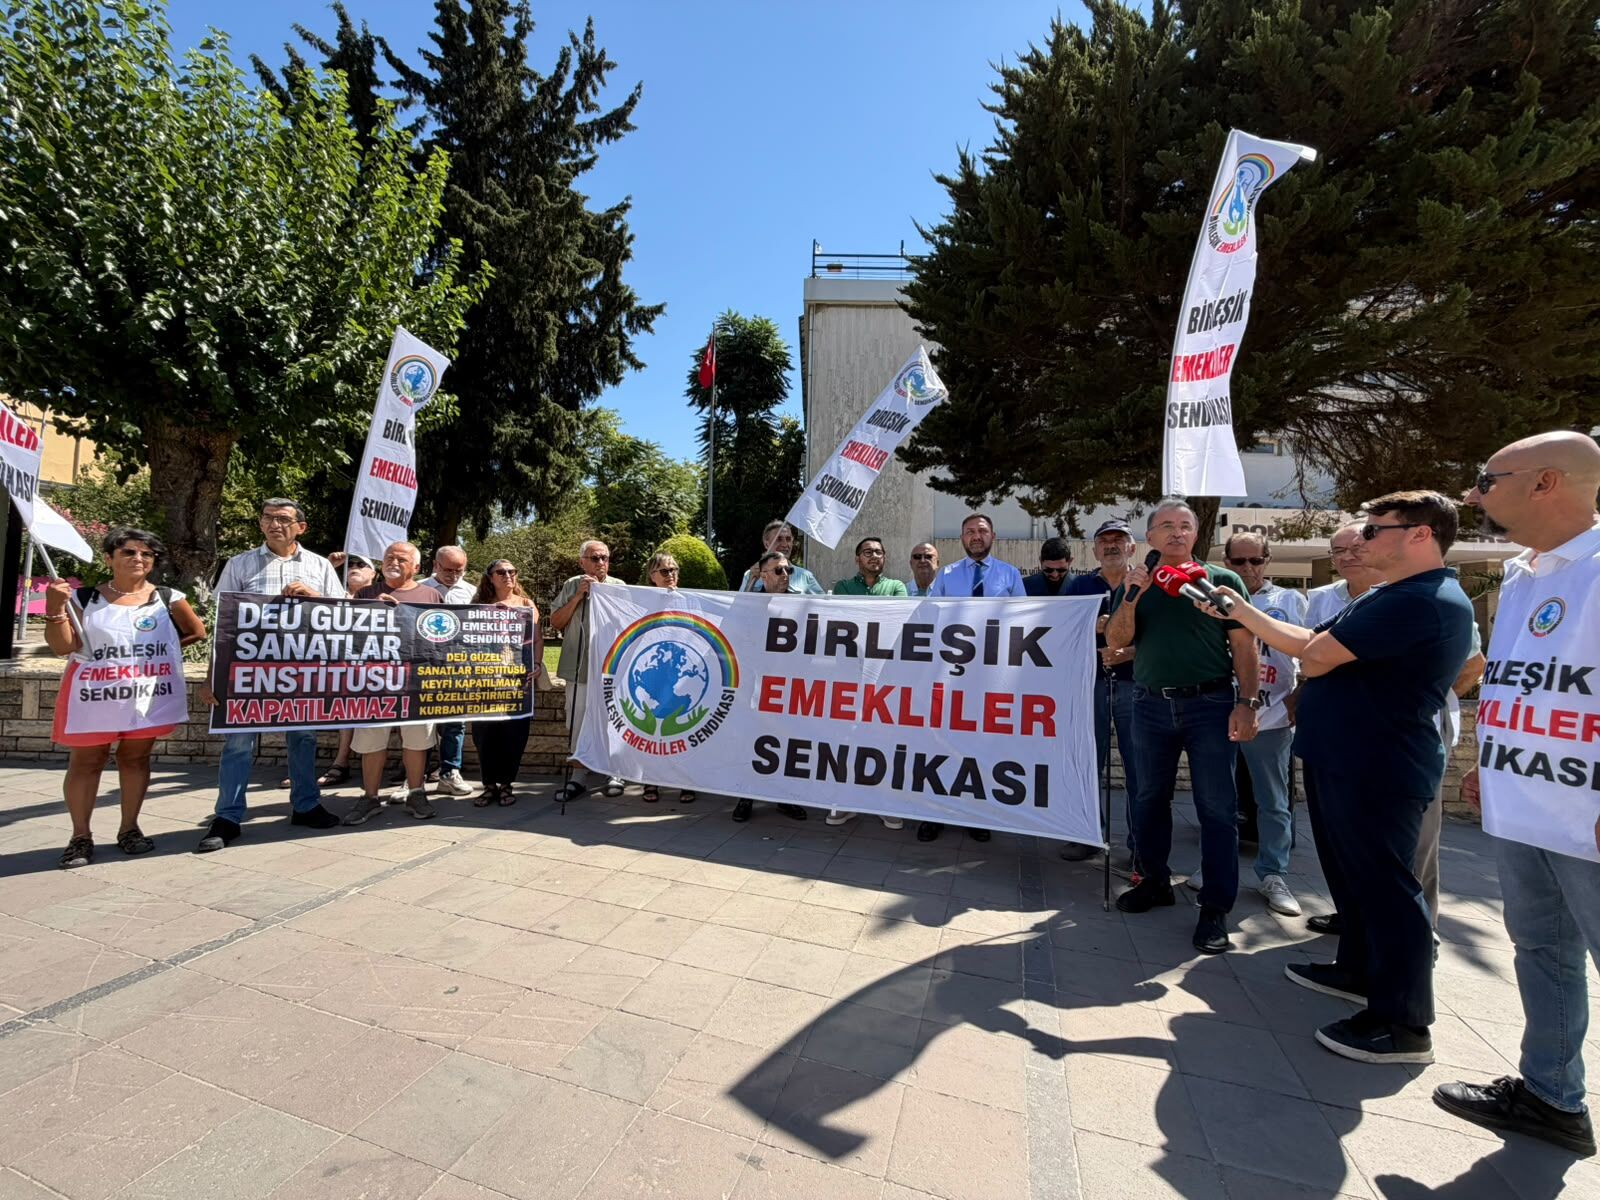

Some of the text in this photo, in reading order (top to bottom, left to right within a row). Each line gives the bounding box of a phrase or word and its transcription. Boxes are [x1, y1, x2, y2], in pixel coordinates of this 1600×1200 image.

[866, 406, 911, 434] BİRLEŞİK
[840, 439, 889, 471] EMEKLİLER
[815, 473, 866, 511] SENDİKASI
[237, 598, 401, 633] DEÜ GÜZEL
[462, 621, 522, 632] EMEKLİLER
[468, 609, 518, 620] BİRLEŞİK
[93, 640, 168, 660] BİRLEŞİK
[235, 632, 402, 660] SANATLAR
[462, 633, 522, 644] SENDİKASI
[765, 613, 1053, 676] BİRLEŞİK
[446, 651, 502, 662] DEÜ GÜZEL
[79, 661, 172, 681] EMEKLİLER
[234, 661, 405, 694] ENSTİTÜSÜ
[417, 666, 472, 676] SANATLAR
[421, 677, 522, 689] KEYFİ KAPATILMAYA
[1483, 656, 1596, 696] RLEŞİK
[80, 682, 173, 702] SENDİKASI
[419, 690, 524, 703] VE ÖZELLEŞTİRMEYE
[226, 697, 397, 725] KAPATILAMAZ
[419, 704, 464, 716] KURBAN
[467, 702, 517, 714] EDİLEMEZ
[603, 677, 736, 756] BİRLEŞİK EMEKLİLER SENDİKASI
[758, 675, 1057, 738] EMEKLİLER
[1477, 697, 1600, 743] KLİLER
[751, 734, 1049, 808] SENDİKASI
